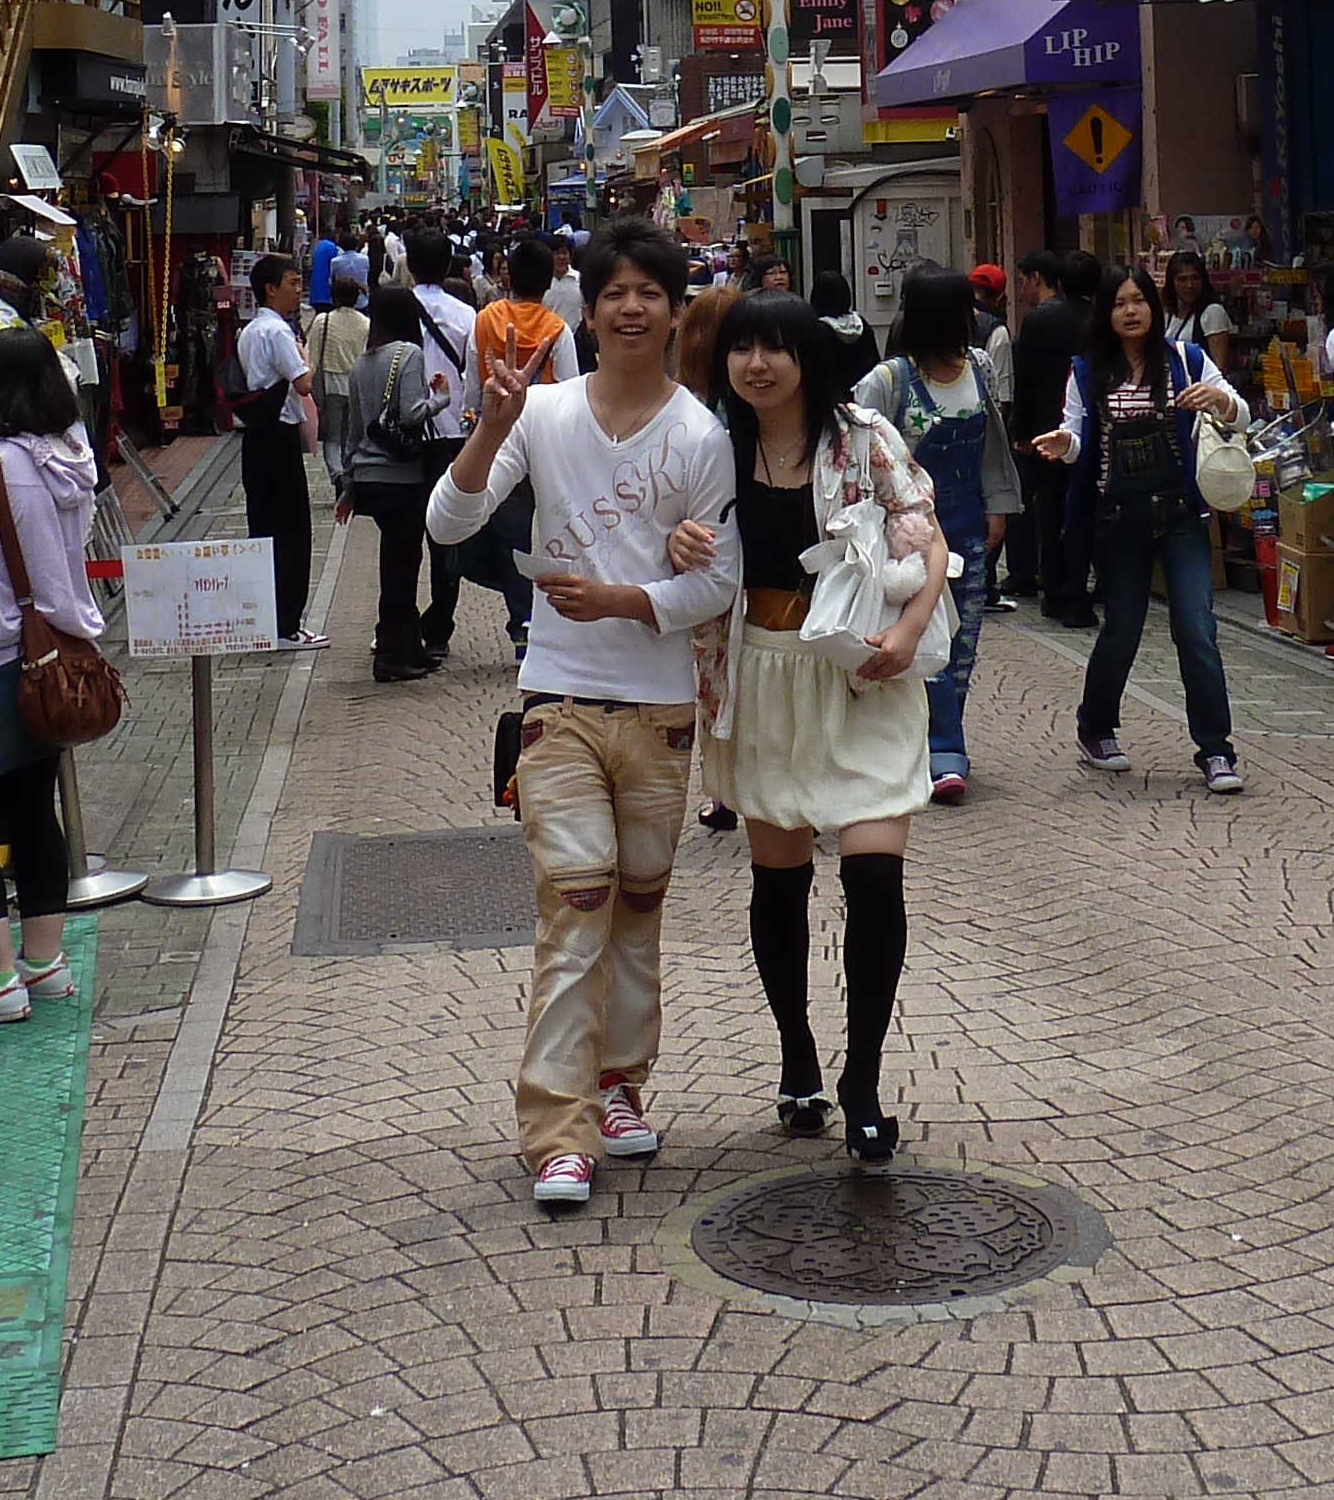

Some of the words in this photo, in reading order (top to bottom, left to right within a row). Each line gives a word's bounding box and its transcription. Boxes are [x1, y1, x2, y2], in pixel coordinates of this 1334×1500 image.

[695, 1, 721, 12] NO!!
[813, 14, 854, 33] Jane
[1044, 28, 1088, 55] LIP
[1073, 41, 1121, 67] HIP
